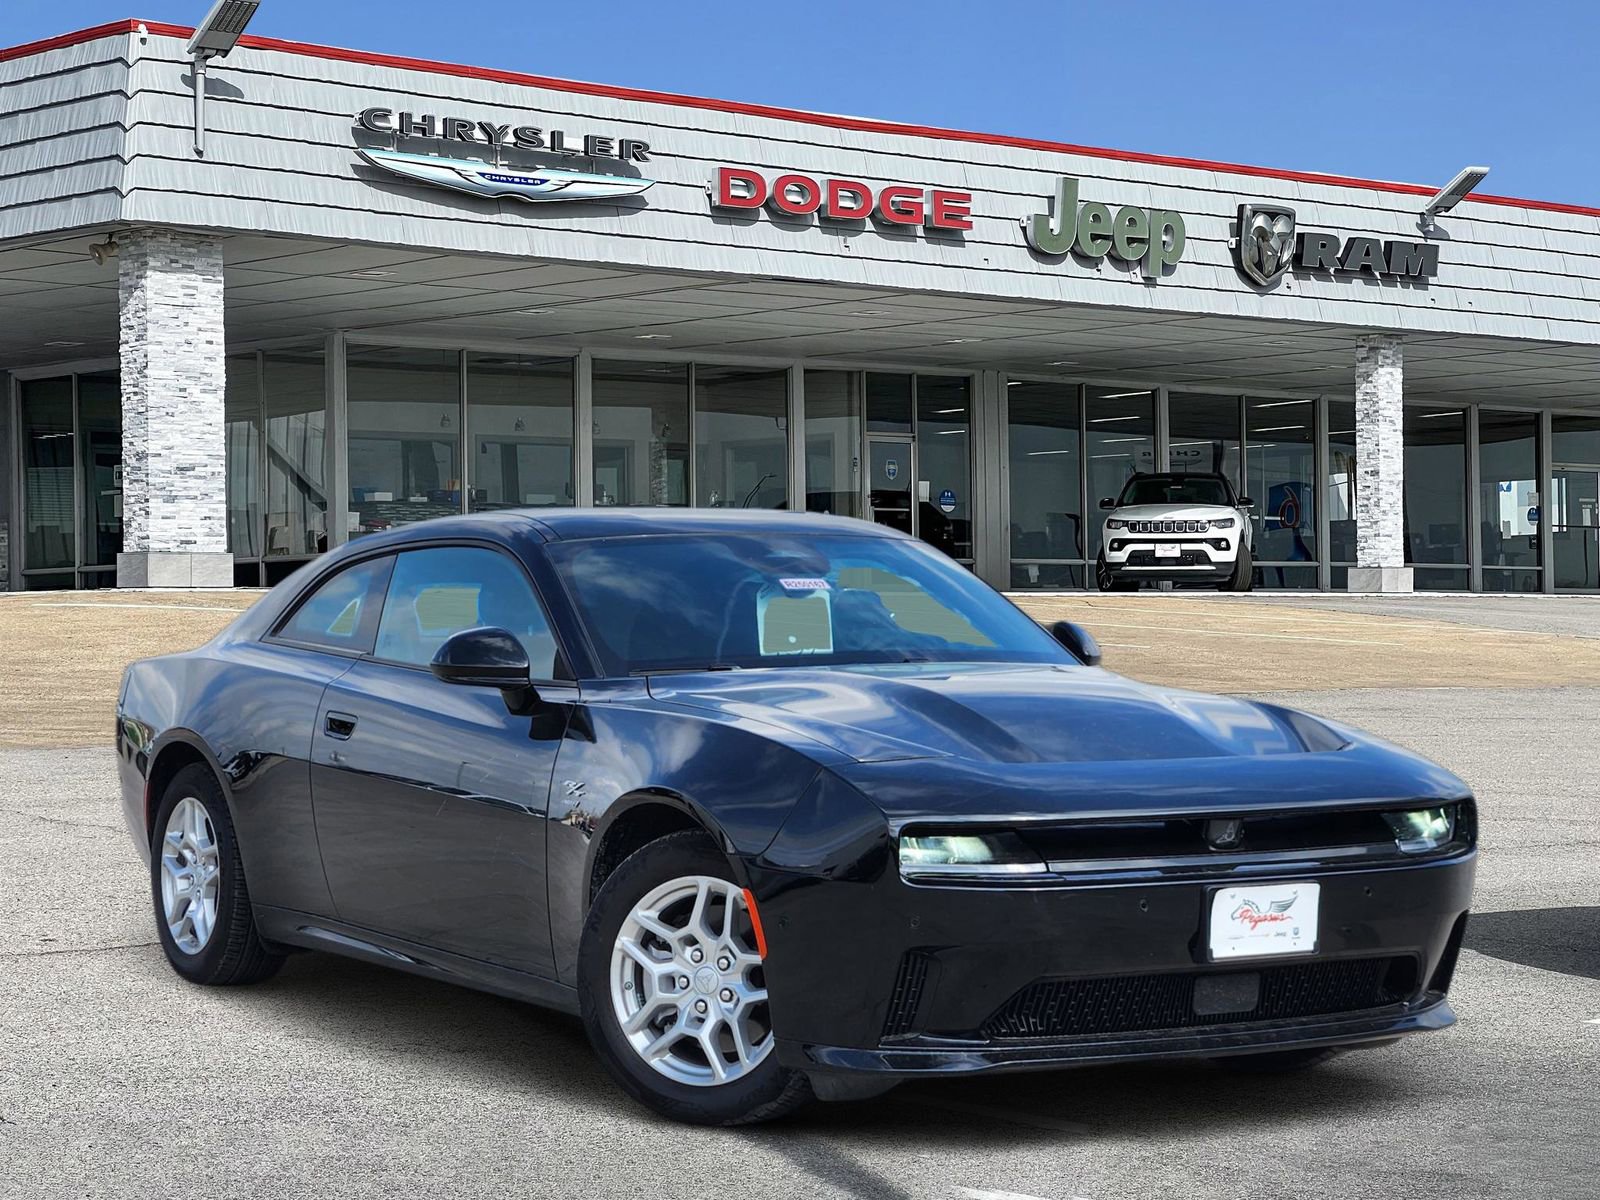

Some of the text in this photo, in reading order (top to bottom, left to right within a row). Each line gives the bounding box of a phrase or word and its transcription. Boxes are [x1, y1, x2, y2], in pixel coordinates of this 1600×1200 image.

[359, 107, 652, 162] CHRYSLER
[484, 174, 541, 185] CHRYSLER
[712, 167, 974, 231] DODGE
[1027, 177, 1186, 278] Jeep
[1297, 232, 1440, 277] RAM
